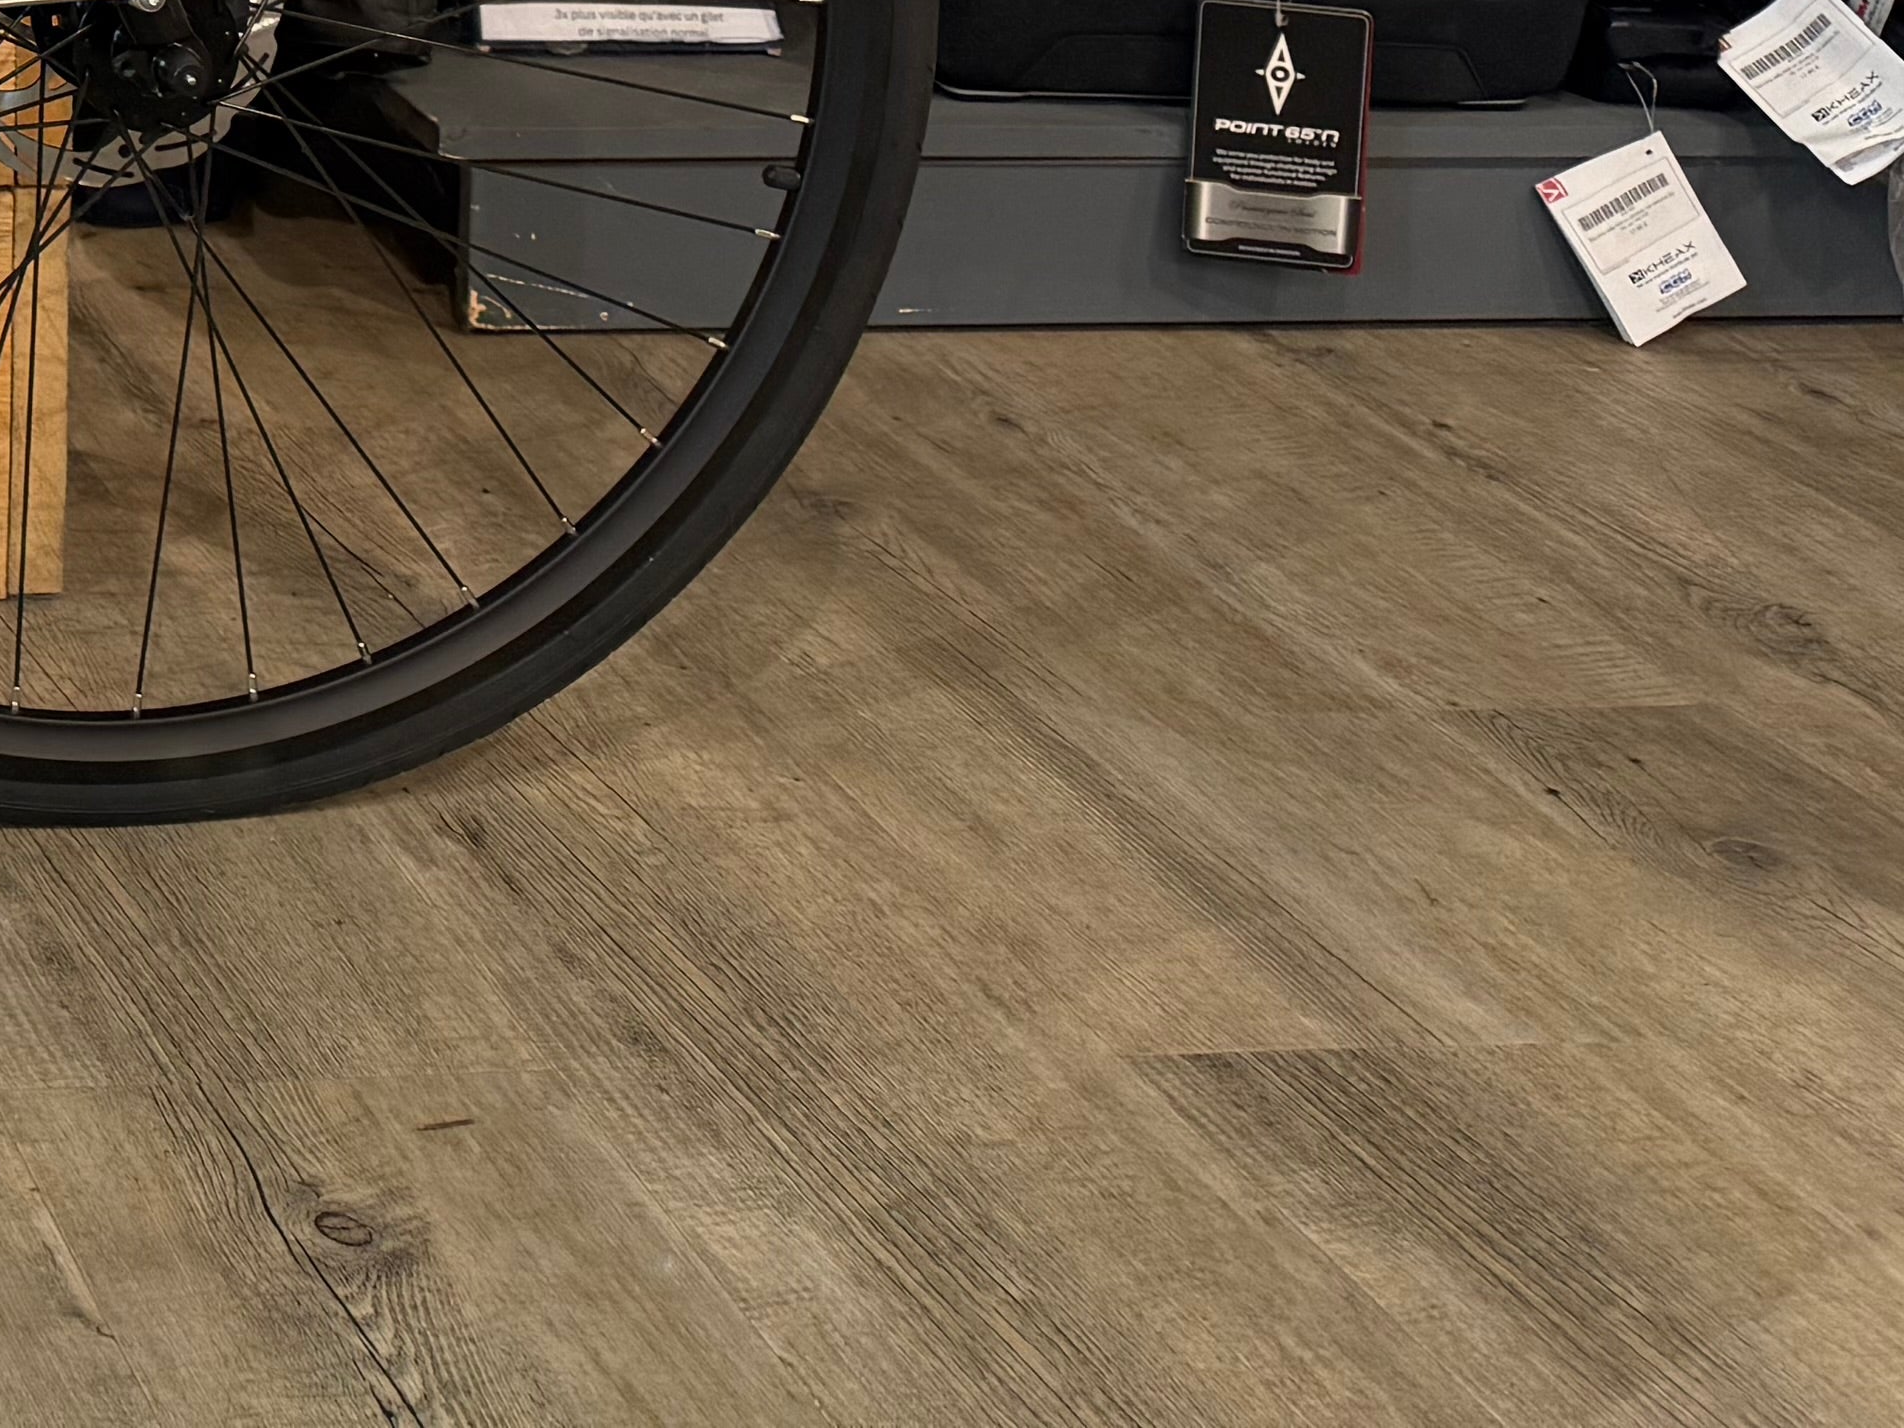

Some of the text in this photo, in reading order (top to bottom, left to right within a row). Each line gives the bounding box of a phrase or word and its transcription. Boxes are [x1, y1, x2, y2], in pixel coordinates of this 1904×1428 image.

[555, 8, 568, 20] 3x
[571, 8, 596, 23] plus
[600, 8, 635, 22] visible
[685, 12, 699, 22] un
[702, 10, 724, 26] gilet
[578, 27, 593, 38] de
[597, 26, 668, 40] signalisation
[1214, 118, 1284, 136] POINT
[1644, 240, 1696, 275] KHEAX
